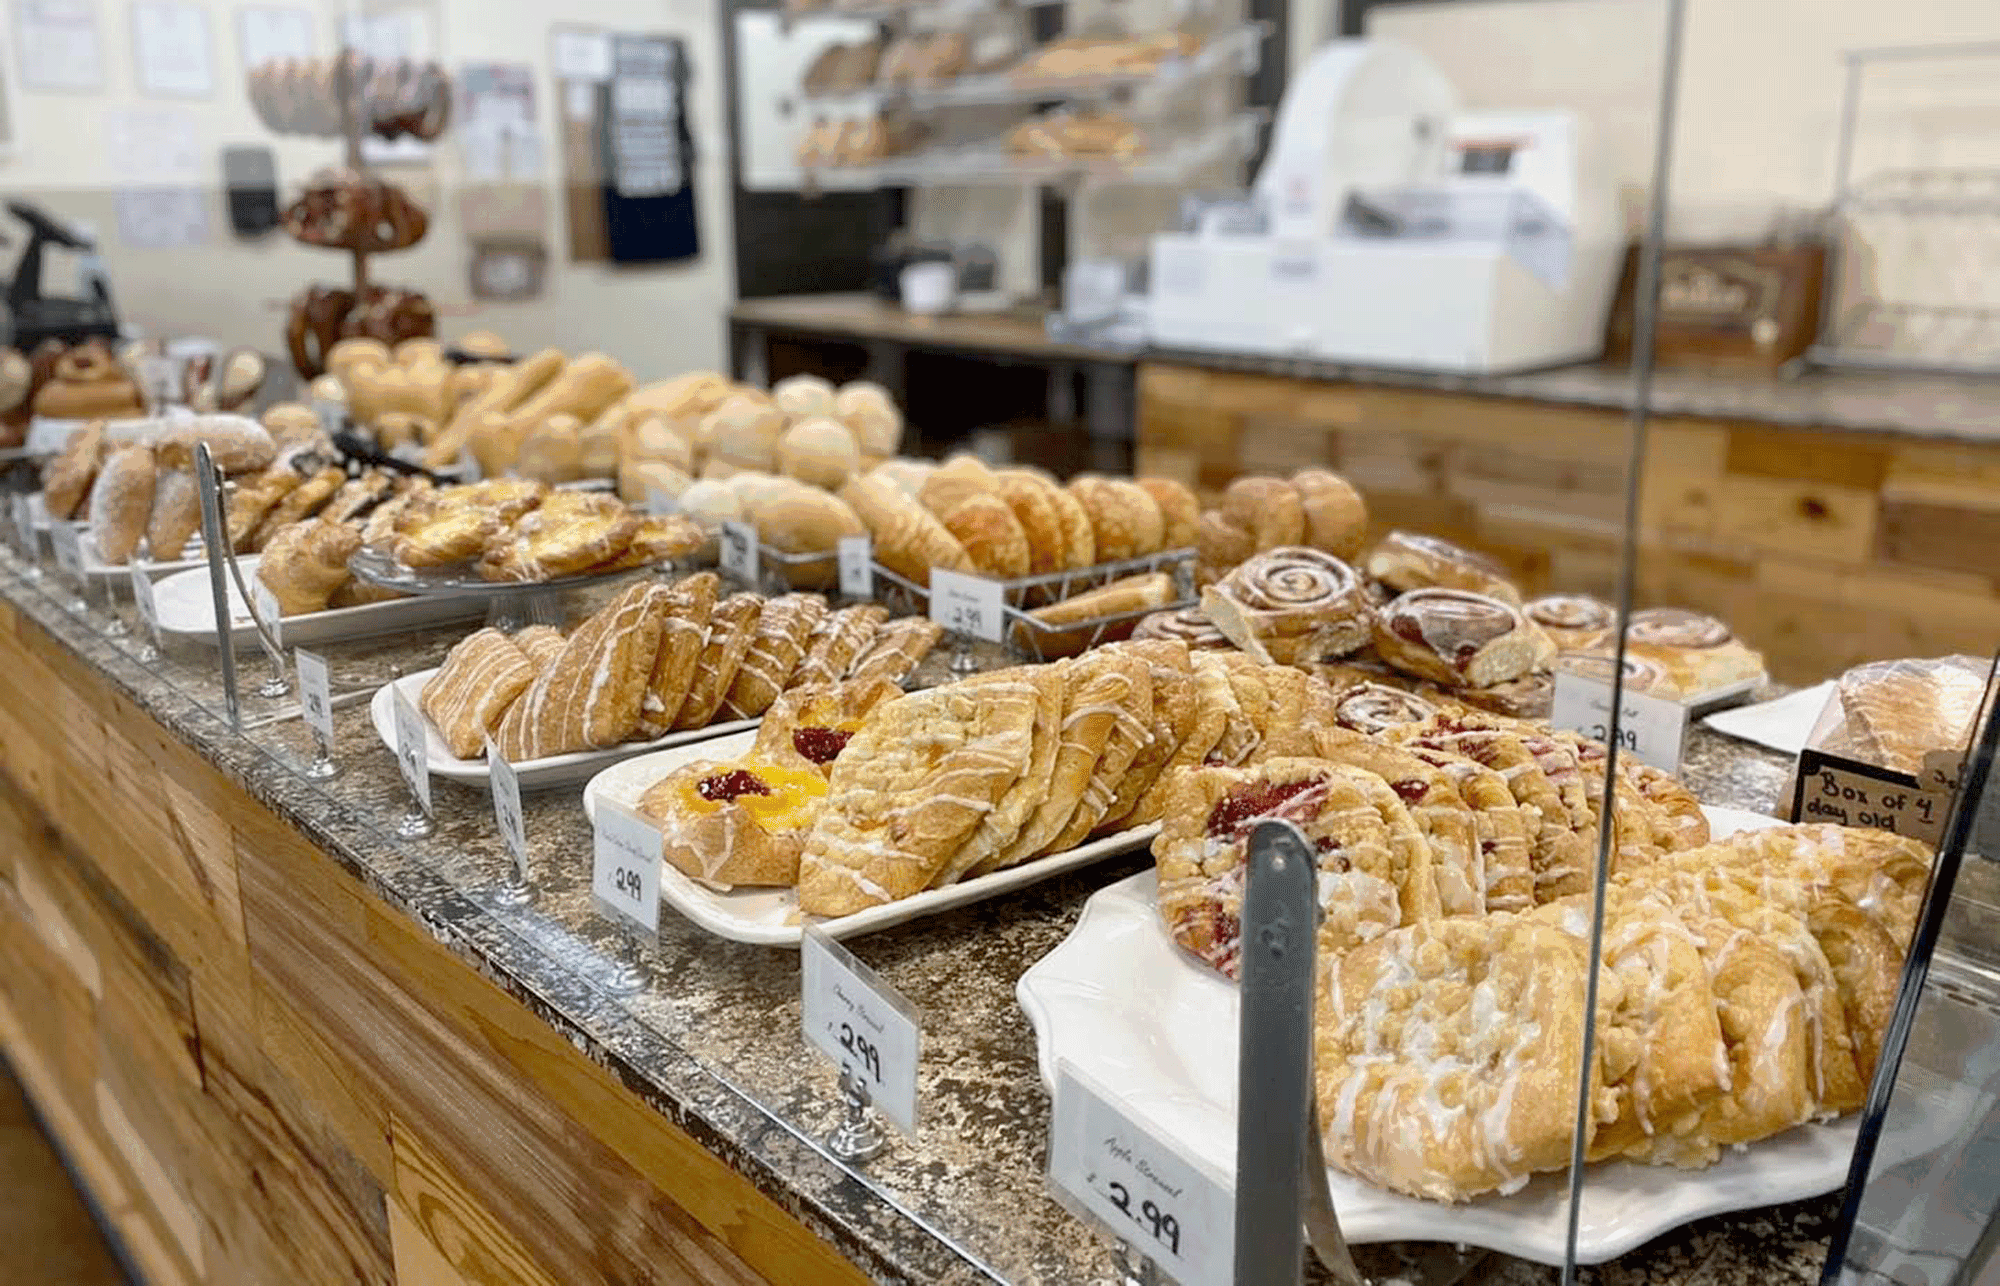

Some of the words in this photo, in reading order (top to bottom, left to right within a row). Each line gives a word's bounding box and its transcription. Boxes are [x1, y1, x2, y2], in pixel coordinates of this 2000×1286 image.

[1807, 797, 1847, 826] day
[1858, 811, 1896, 832] old
[1820, 771, 1868, 804] Box
[1882, 795, 1907, 811] of
[1916, 798, 1934, 824] 4
[1104, 1137, 1132, 1162] Apple
[1109, 1182, 1180, 1255] 2.99
